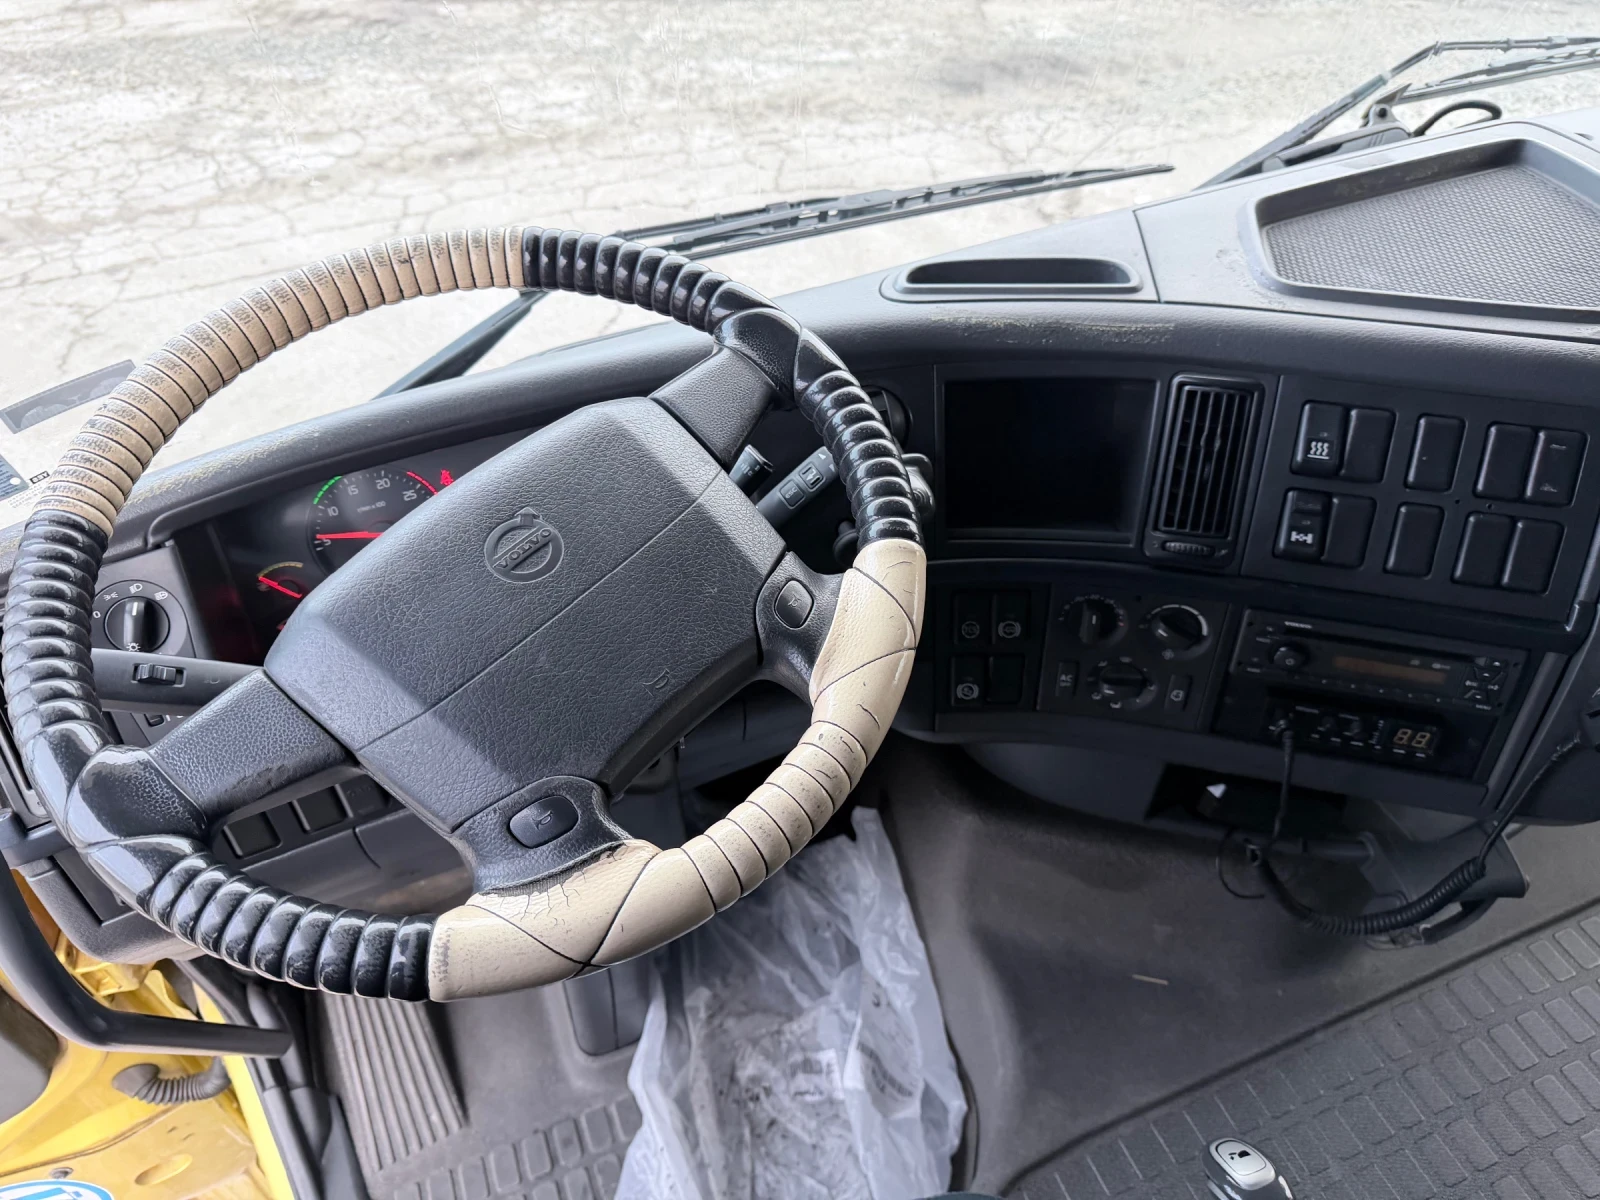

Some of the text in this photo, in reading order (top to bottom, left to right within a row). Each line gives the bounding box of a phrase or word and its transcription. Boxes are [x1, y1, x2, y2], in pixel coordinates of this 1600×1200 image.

[376, 478, 391, 490] 20
[348, 485, 359, 496] 15
[403, 490, 417, 501] 25
[328, 507, 339, 517] 10
[493, 527, 552, 569] VOLVO
